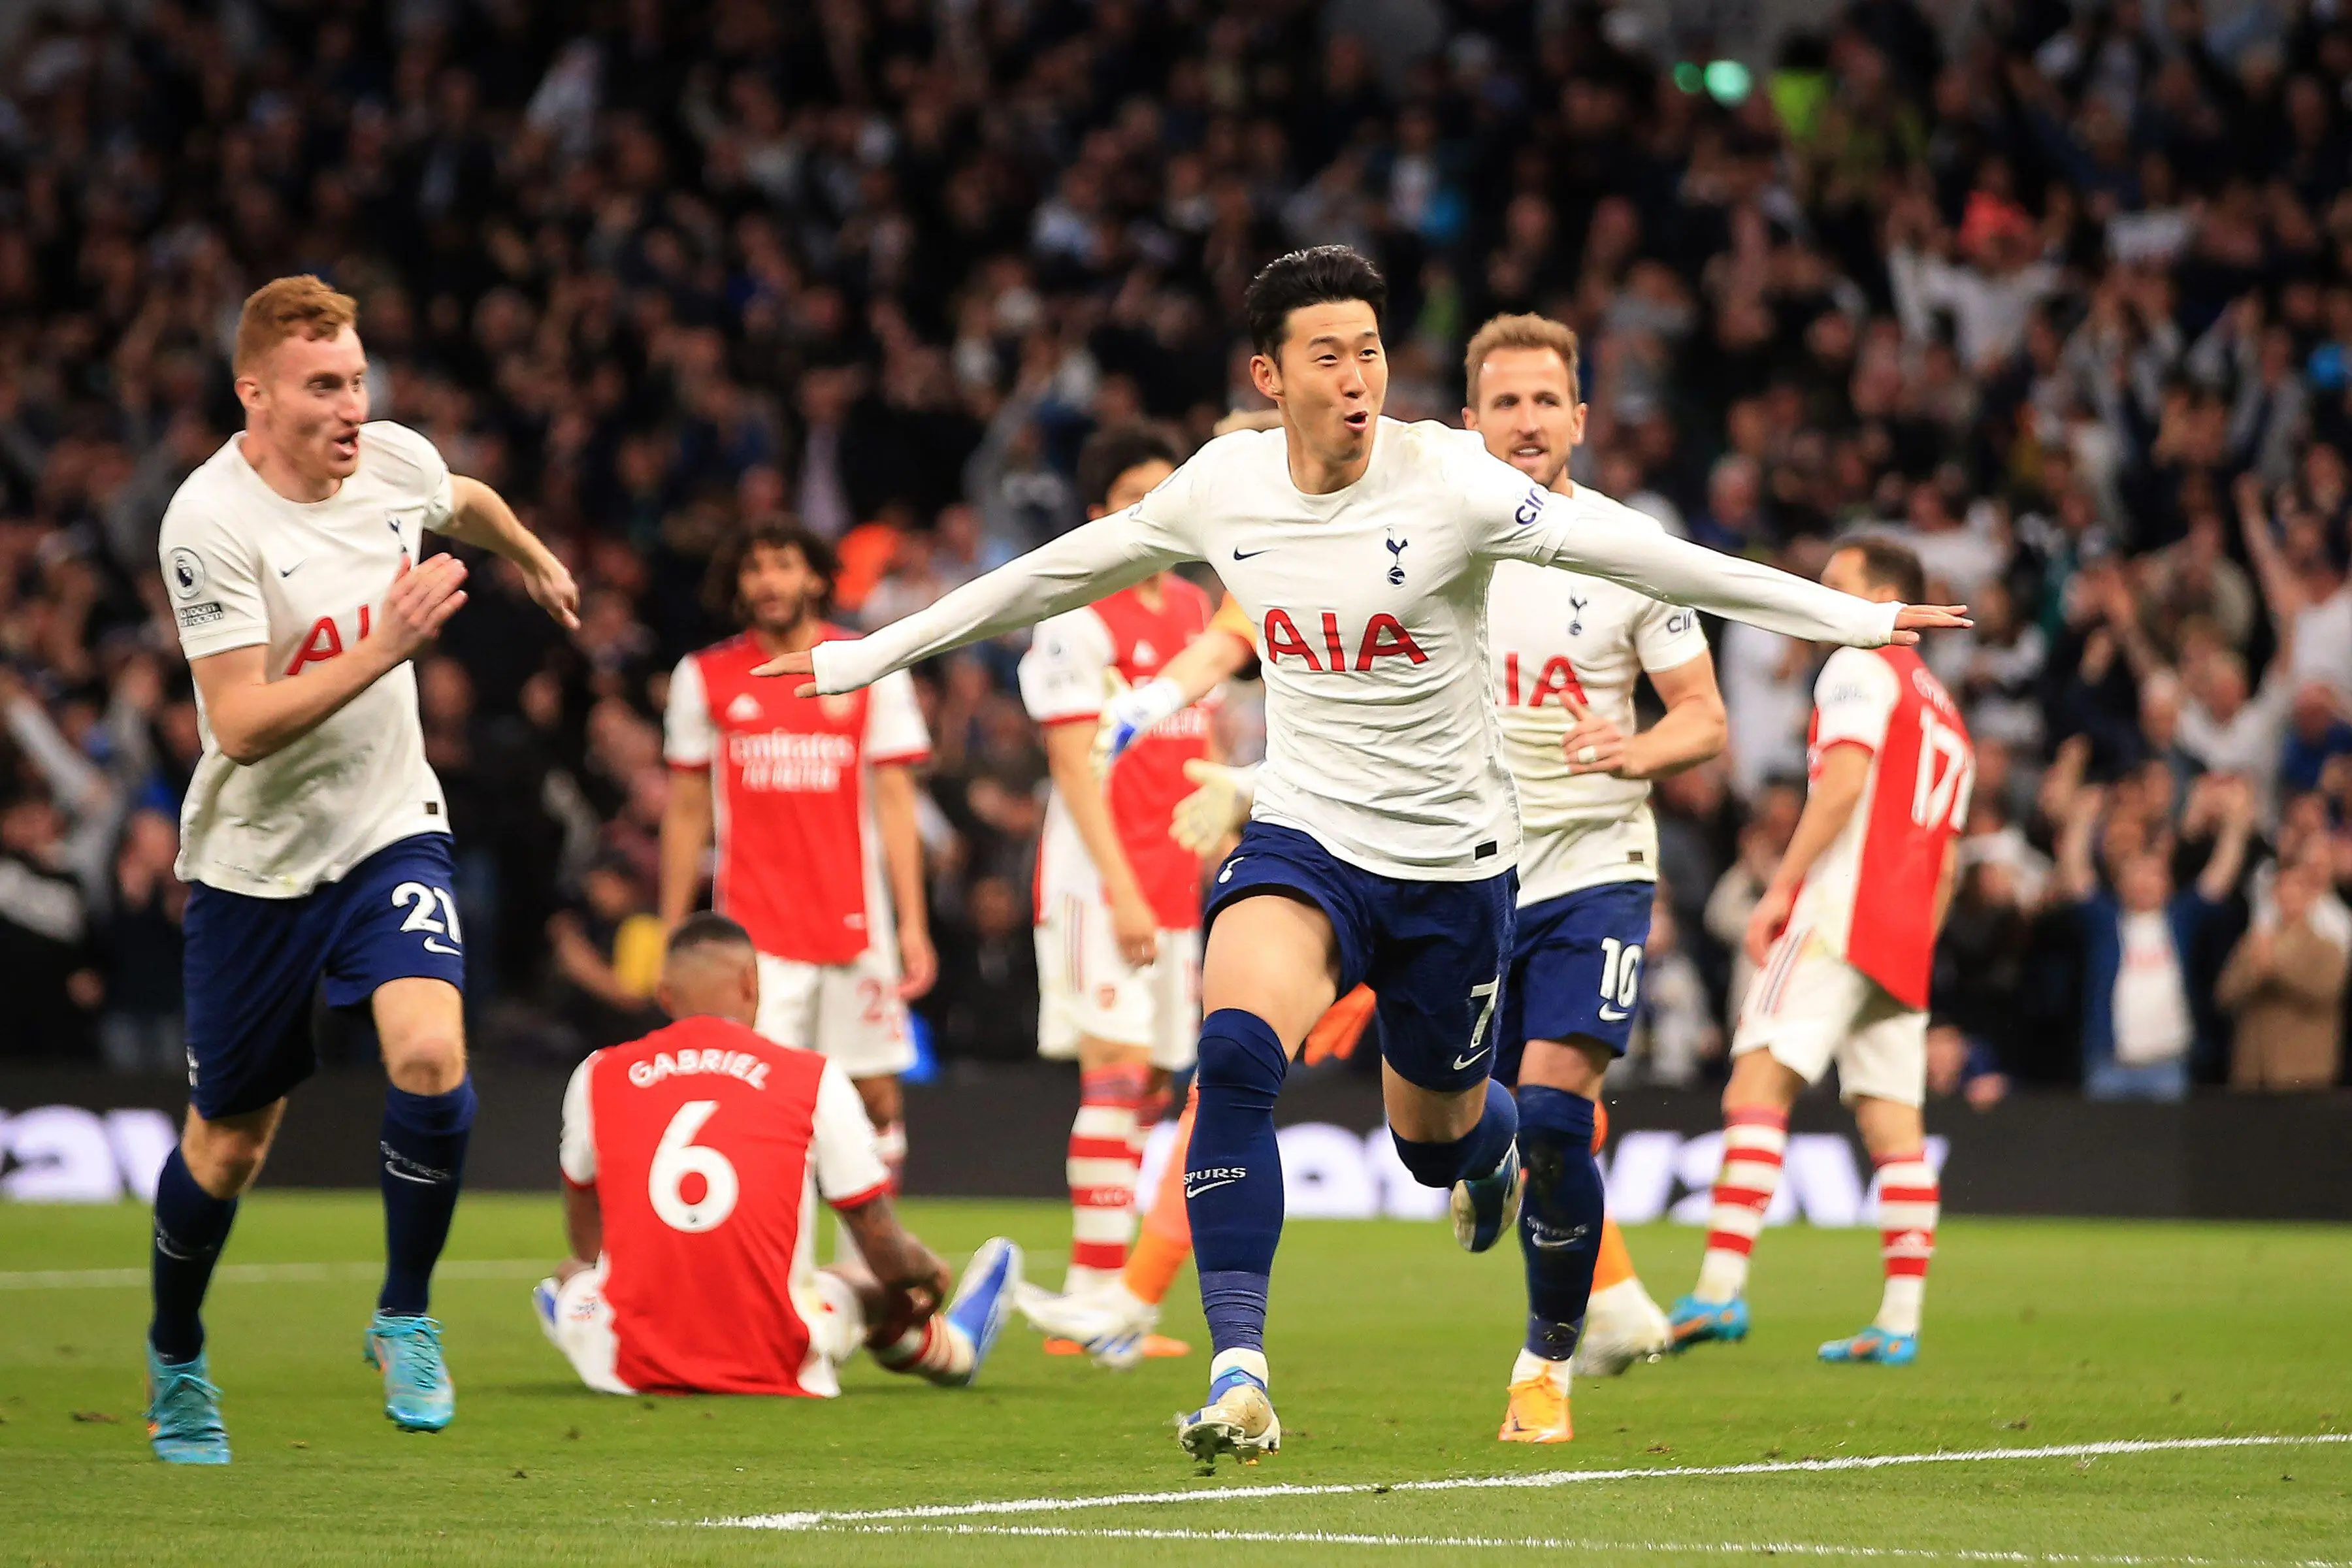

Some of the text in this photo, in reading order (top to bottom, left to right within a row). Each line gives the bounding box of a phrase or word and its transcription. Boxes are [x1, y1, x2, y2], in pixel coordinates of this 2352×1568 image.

[284, 604, 370, 676] AI
[1265, 608, 1429, 672] AIA
[1494, 650, 1588, 706] IA
[391, 881, 462, 944] 21
[1600, 936, 1643, 1009] 10
[1470, 973, 1500, 1048] 7
[628, 1048, 772, 1091] GABRIEL
[647, 1100, 741, 1234] 6
[1183, 1168, 1247, 1185] SPURS
